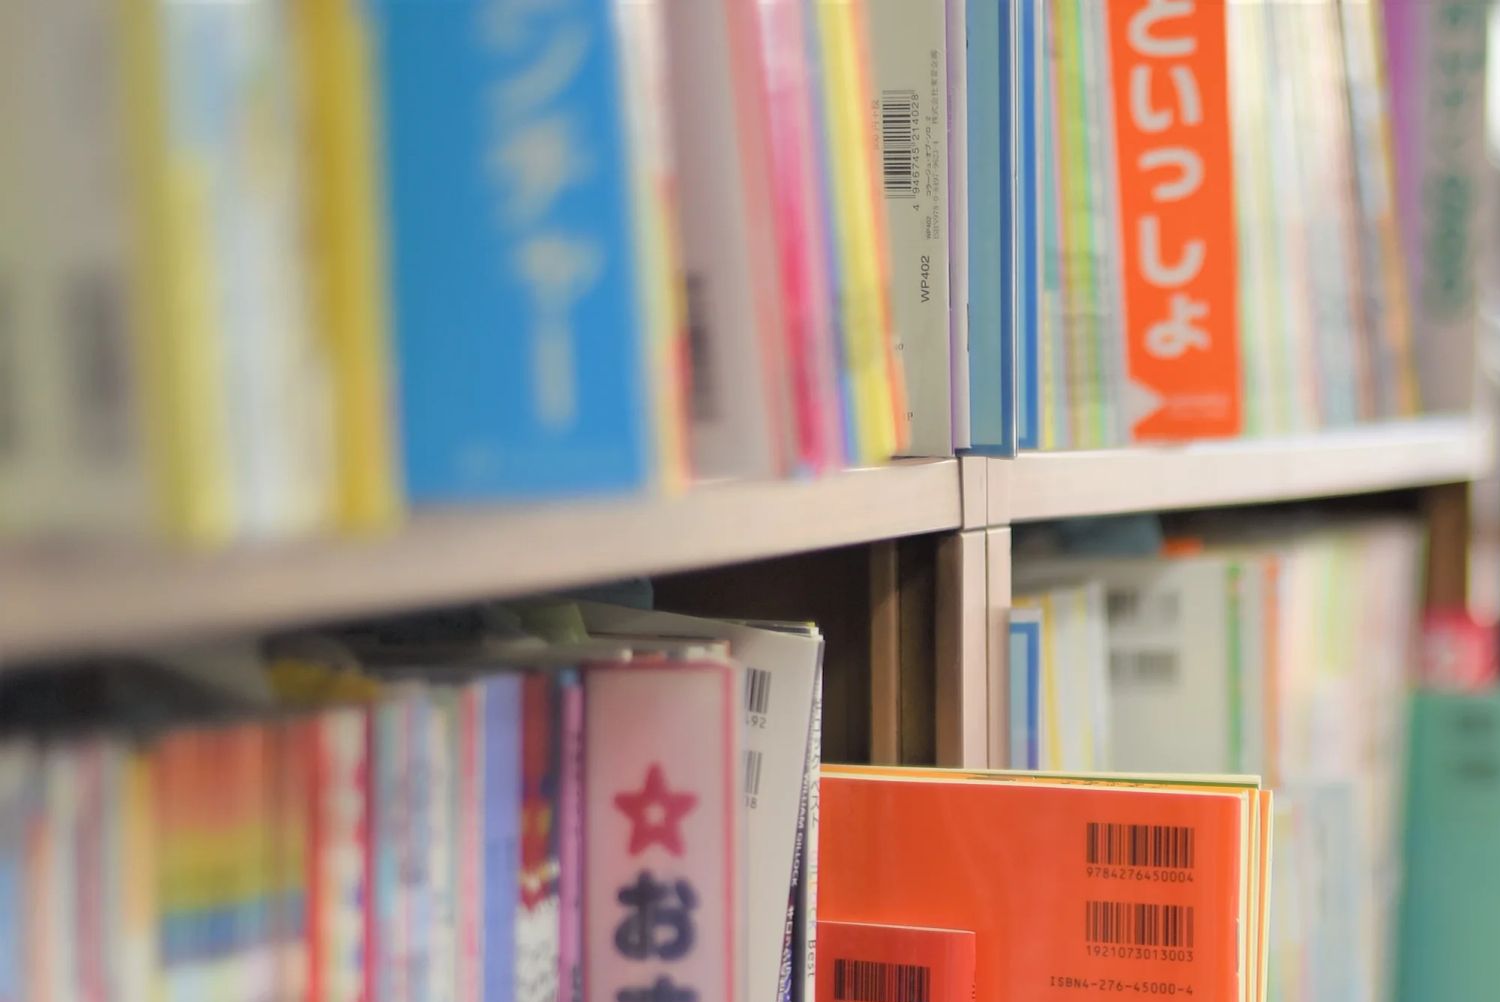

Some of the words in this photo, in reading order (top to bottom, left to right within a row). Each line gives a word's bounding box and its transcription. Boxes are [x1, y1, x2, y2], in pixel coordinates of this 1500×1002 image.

[911, 93, 919, 142] 214028
[1127, 0, 1211, 359] といっしょ
[920, 254, 931, 303] WP402
[1086, 867, 1194, 883] 9784276450004
[807, 939, 817, 978] Best
[1086, 945, 1194, 962] 1921073013003
[1050, 976, 1194, 996] ISBN4-276-45000-4
